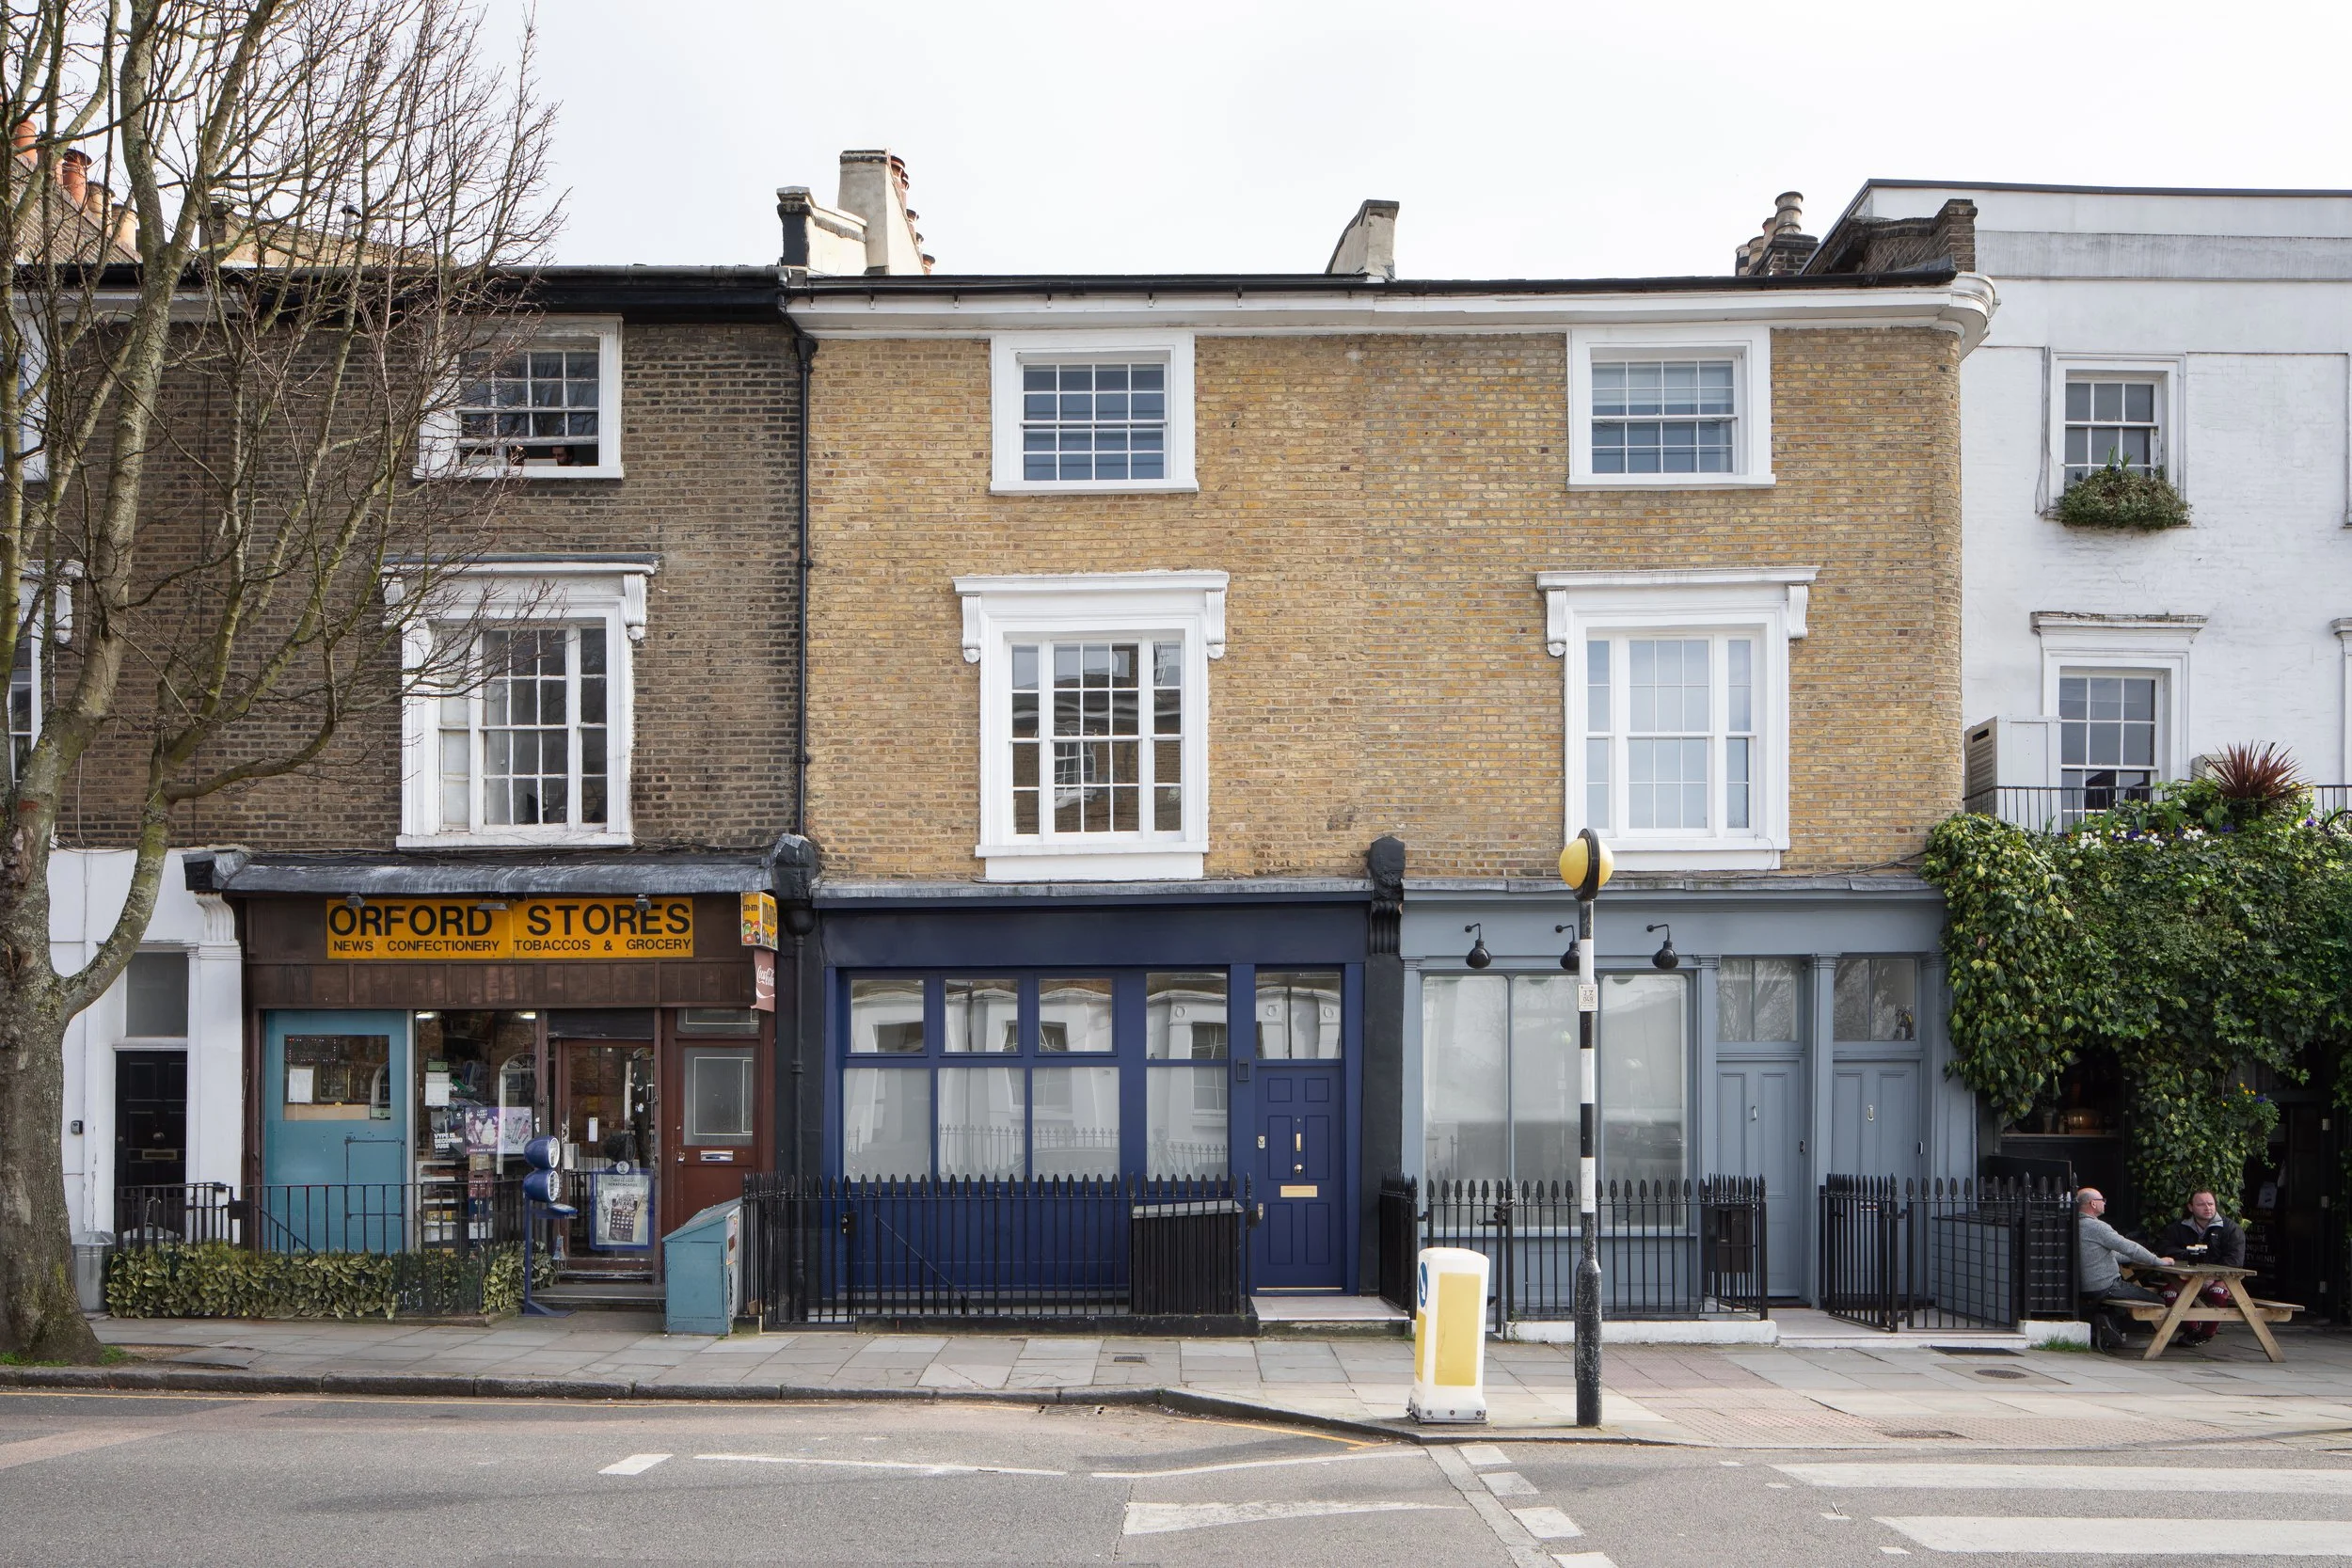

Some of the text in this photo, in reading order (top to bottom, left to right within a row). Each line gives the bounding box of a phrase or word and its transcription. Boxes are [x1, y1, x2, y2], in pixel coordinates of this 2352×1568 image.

[329, 904, 691, 936] ORFORD STORES
[333, 939, 691, 952] NEWS CONFECTIONERY TOBACCOS & GROCERY
